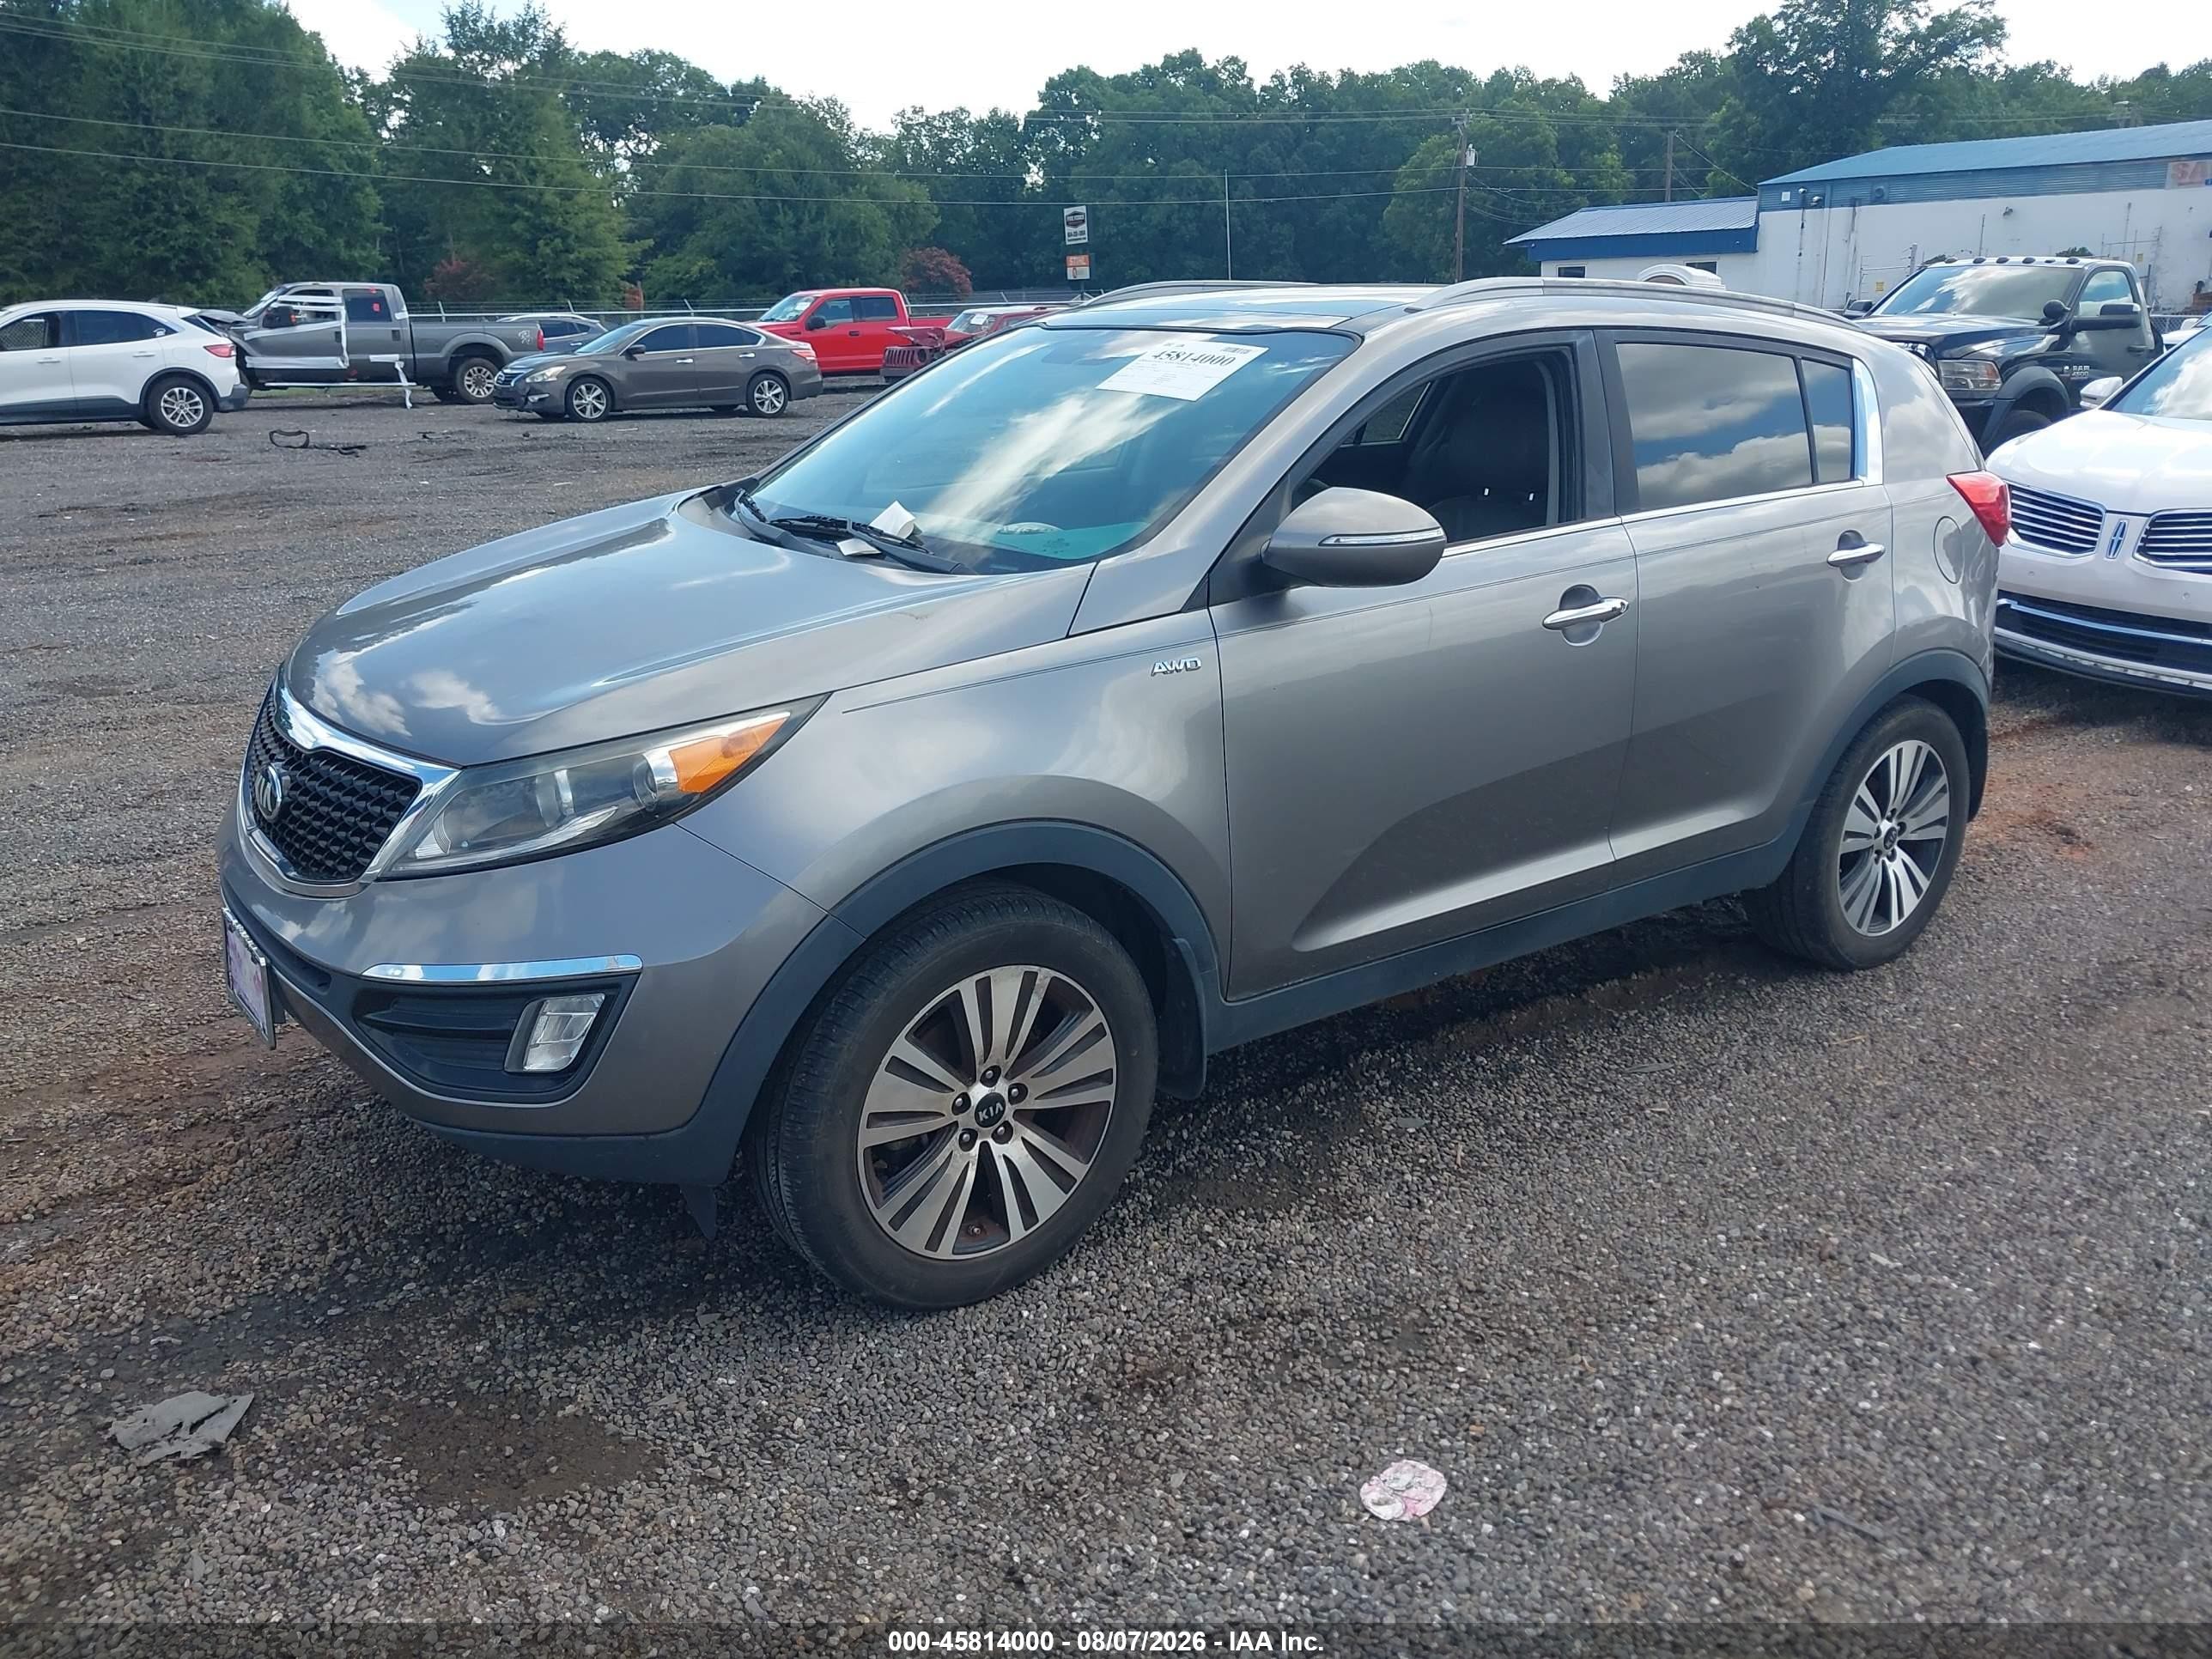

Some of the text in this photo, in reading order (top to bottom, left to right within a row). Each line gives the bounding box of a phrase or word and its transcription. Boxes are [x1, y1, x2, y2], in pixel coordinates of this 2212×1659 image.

[1152, 350, 1237, 367] 45814000
[1151, 657, 1201, 677] AWD
[978, 1102, 1004, 1121] KIA
